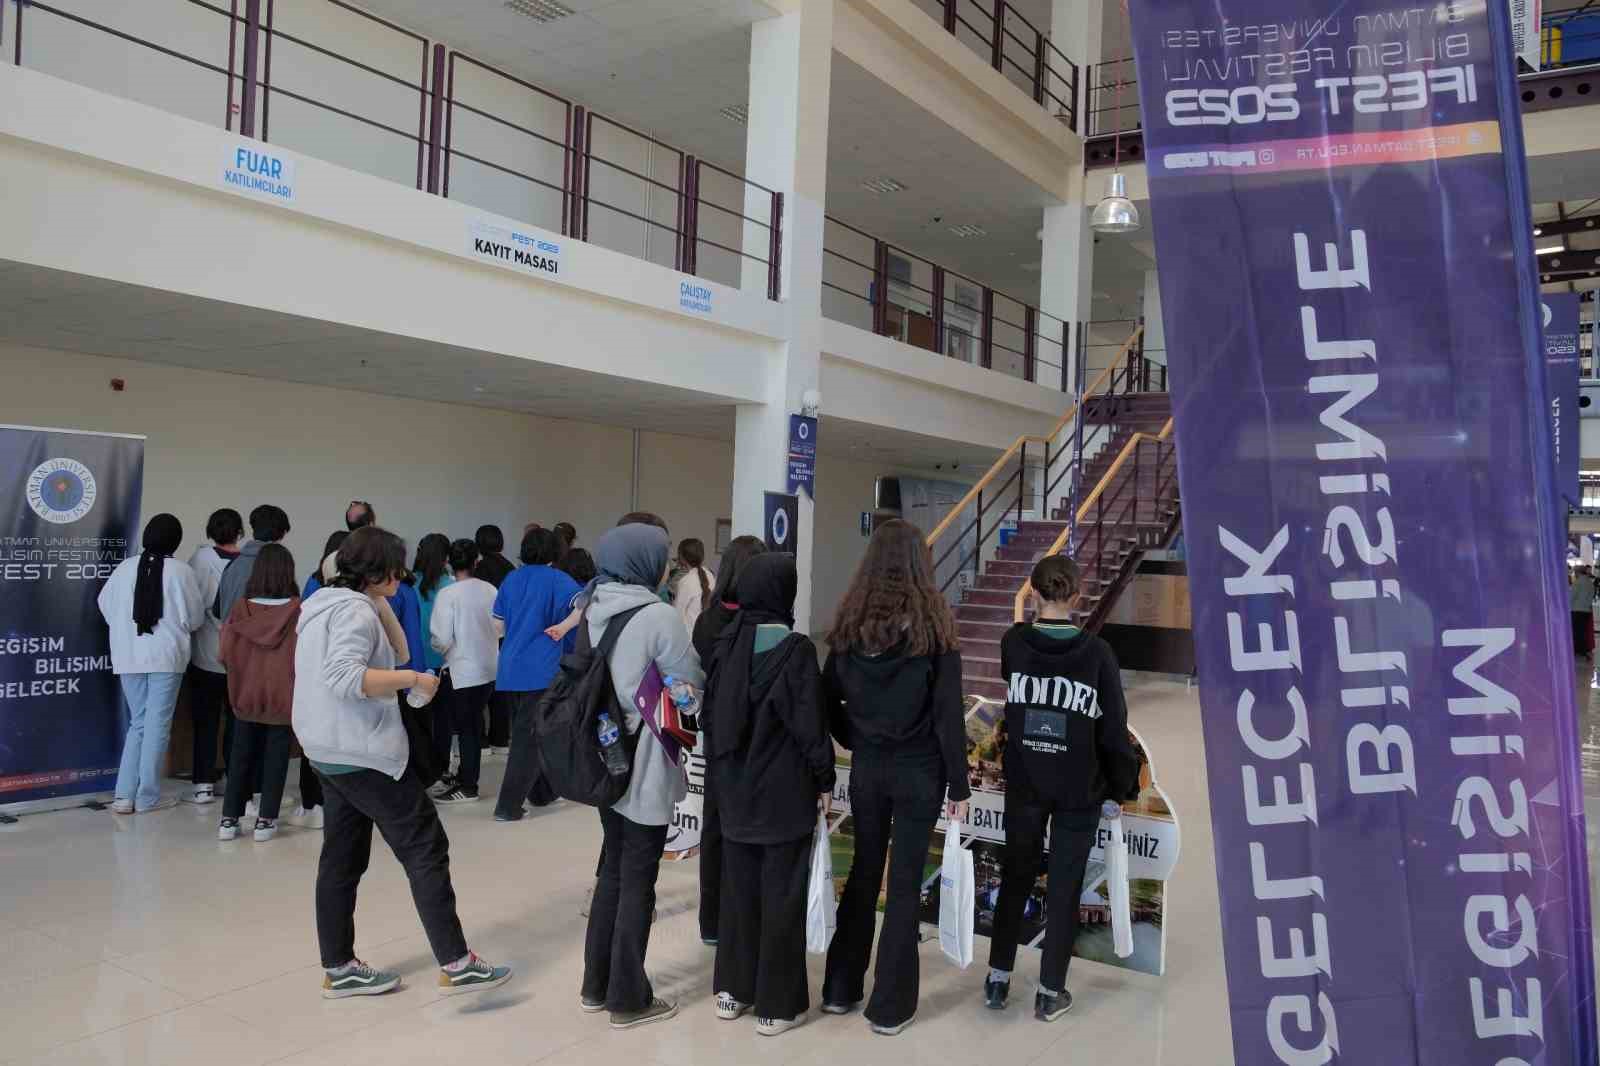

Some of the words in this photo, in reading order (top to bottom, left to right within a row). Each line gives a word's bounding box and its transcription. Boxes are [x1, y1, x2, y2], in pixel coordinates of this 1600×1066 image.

[236, 147, 282, 180] FUAR
[224, 169, 292, 199] KATILIMCILARI
[474, 237, 512, 260] KAYIT
[514, 249, 558, 274] MASASI
